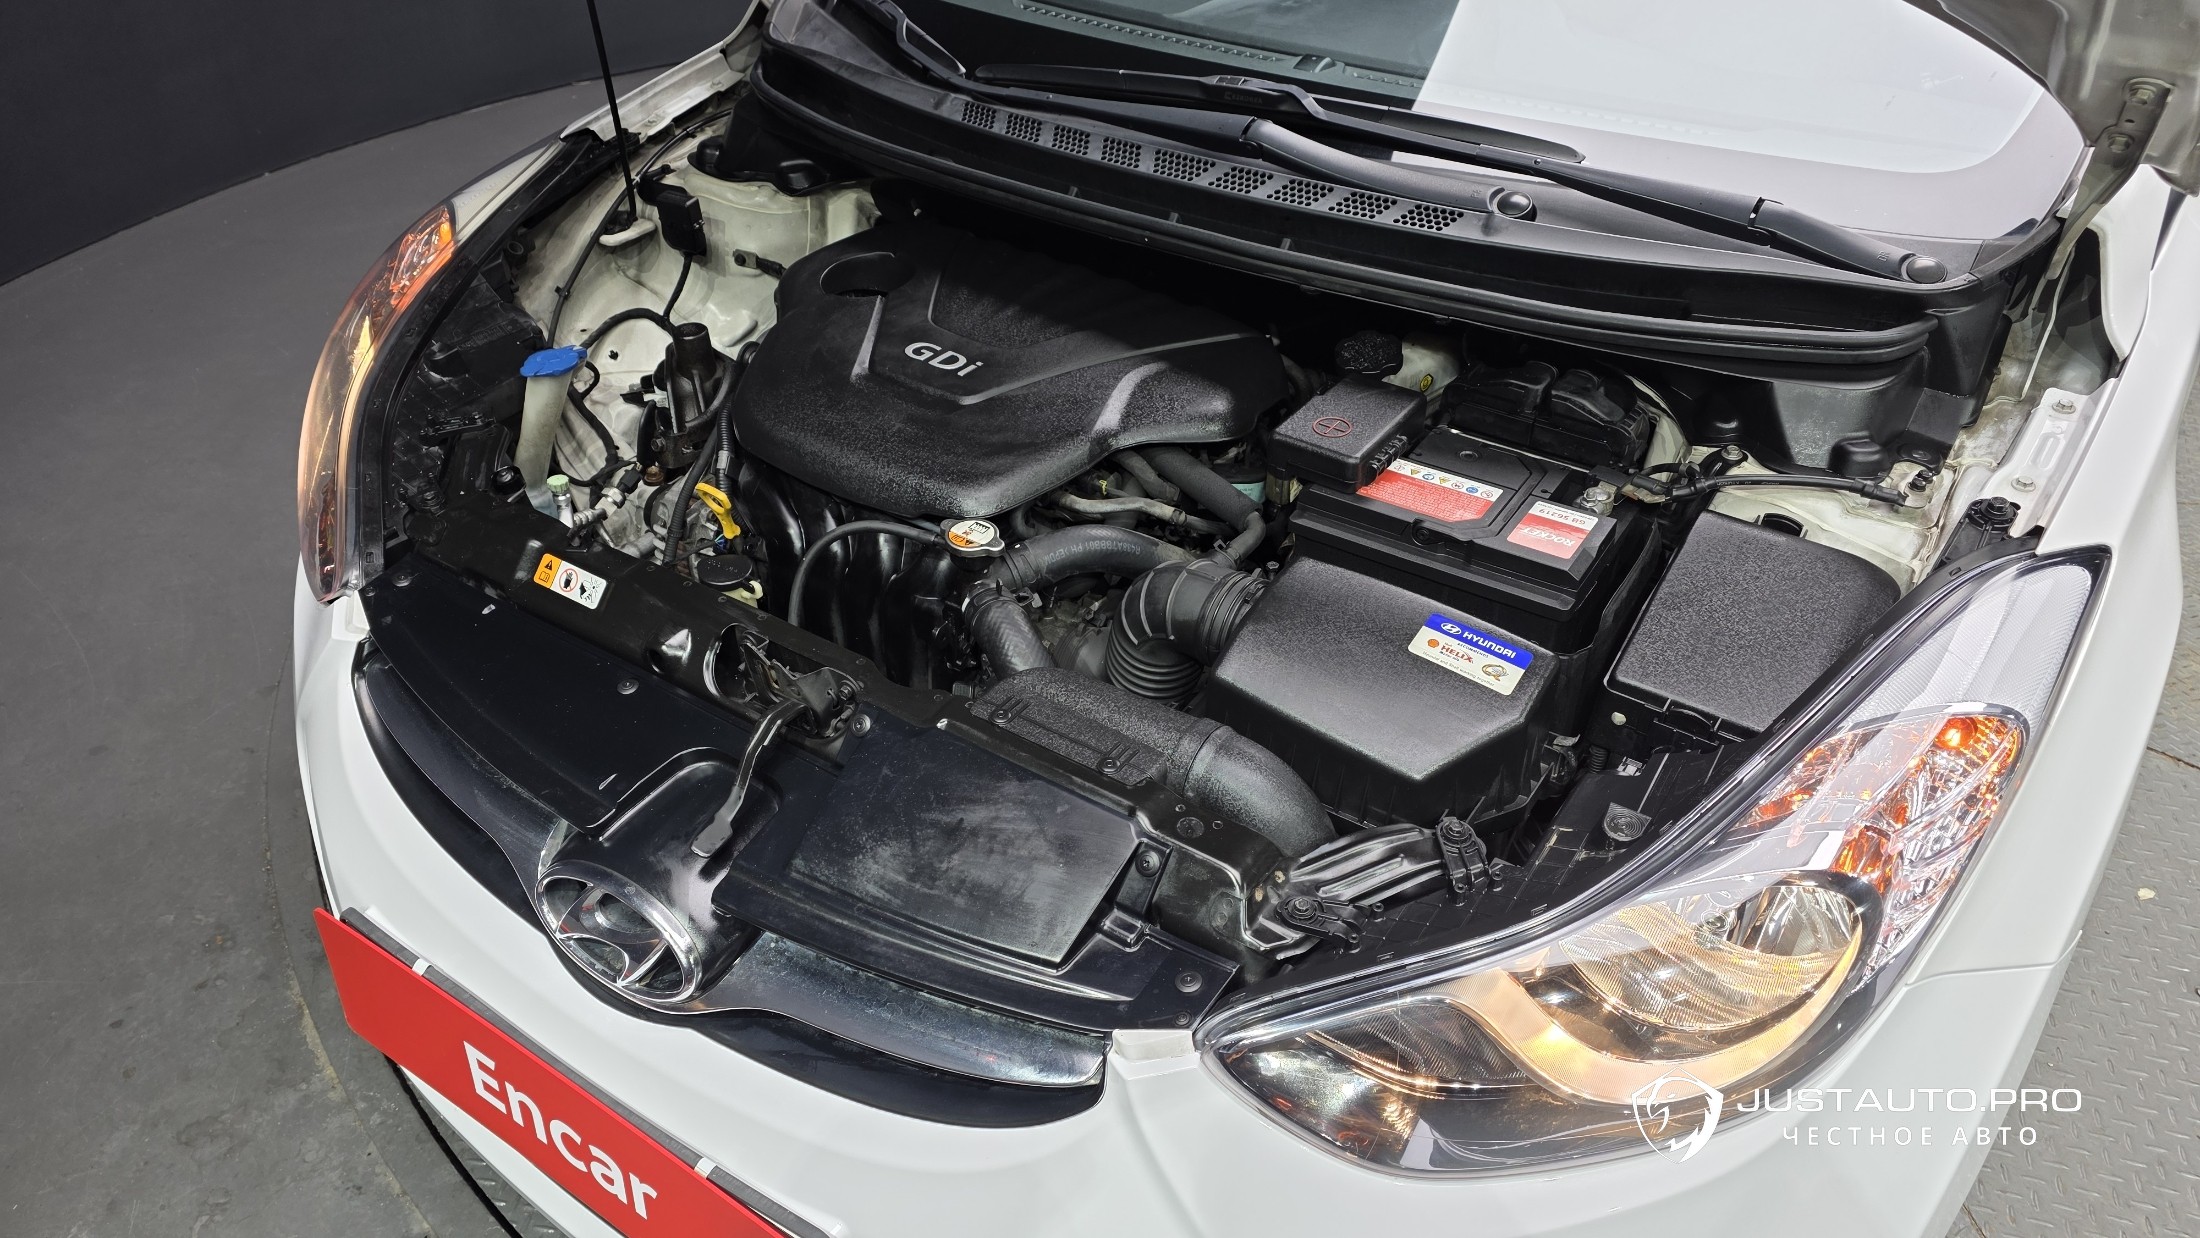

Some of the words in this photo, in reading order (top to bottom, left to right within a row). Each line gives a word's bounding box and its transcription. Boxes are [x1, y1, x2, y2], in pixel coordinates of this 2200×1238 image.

[904, 342, 984, 377] GDi
[1538, 508, 1570, 521] 56219
[1571, 517, 1586, 525] GB
[1520, 526, 1576, 547] ROCKET
[1440, 644, 1473, 663] HELIX
[1462, 631, 1517, 659] HYUNDAI
[462, 1040, 658, 1220] Encar
